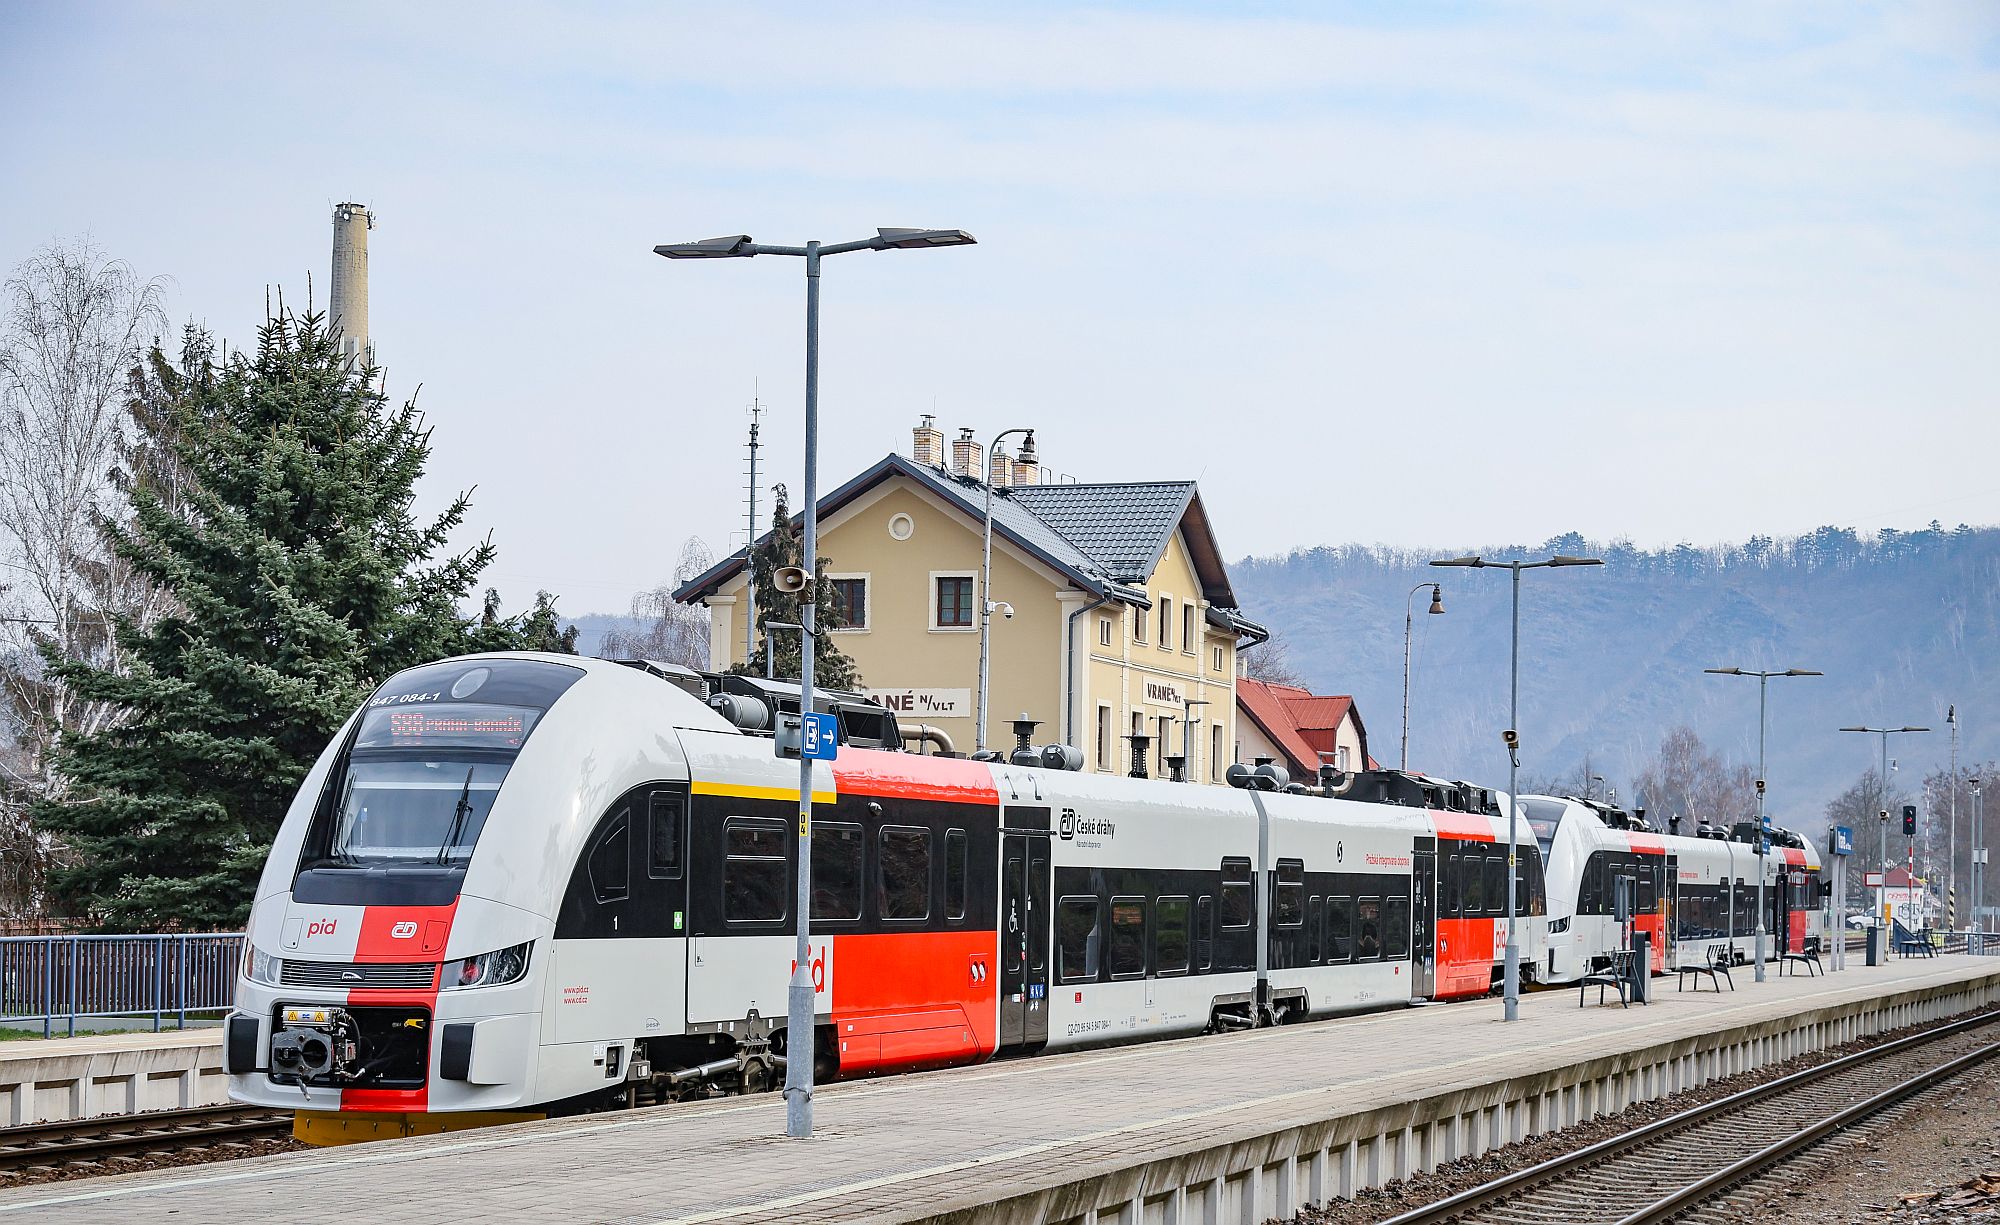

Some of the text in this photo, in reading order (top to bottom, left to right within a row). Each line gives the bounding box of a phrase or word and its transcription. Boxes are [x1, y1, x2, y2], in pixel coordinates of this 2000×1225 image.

[370, 692, 441, 707] 847 084-1
[870, 690, 914, 711] ANÉ
[1147, 682, 1171, 702] VRANÉ
[1077, 814, 1115, 840] České dráhy
[307, 918, 338, 938] pid
[613, 915, 618, 930] 1
[563, 985, 589, 995] www.pid.cz
[563, 996, 588, 1004] www.cd.cz
